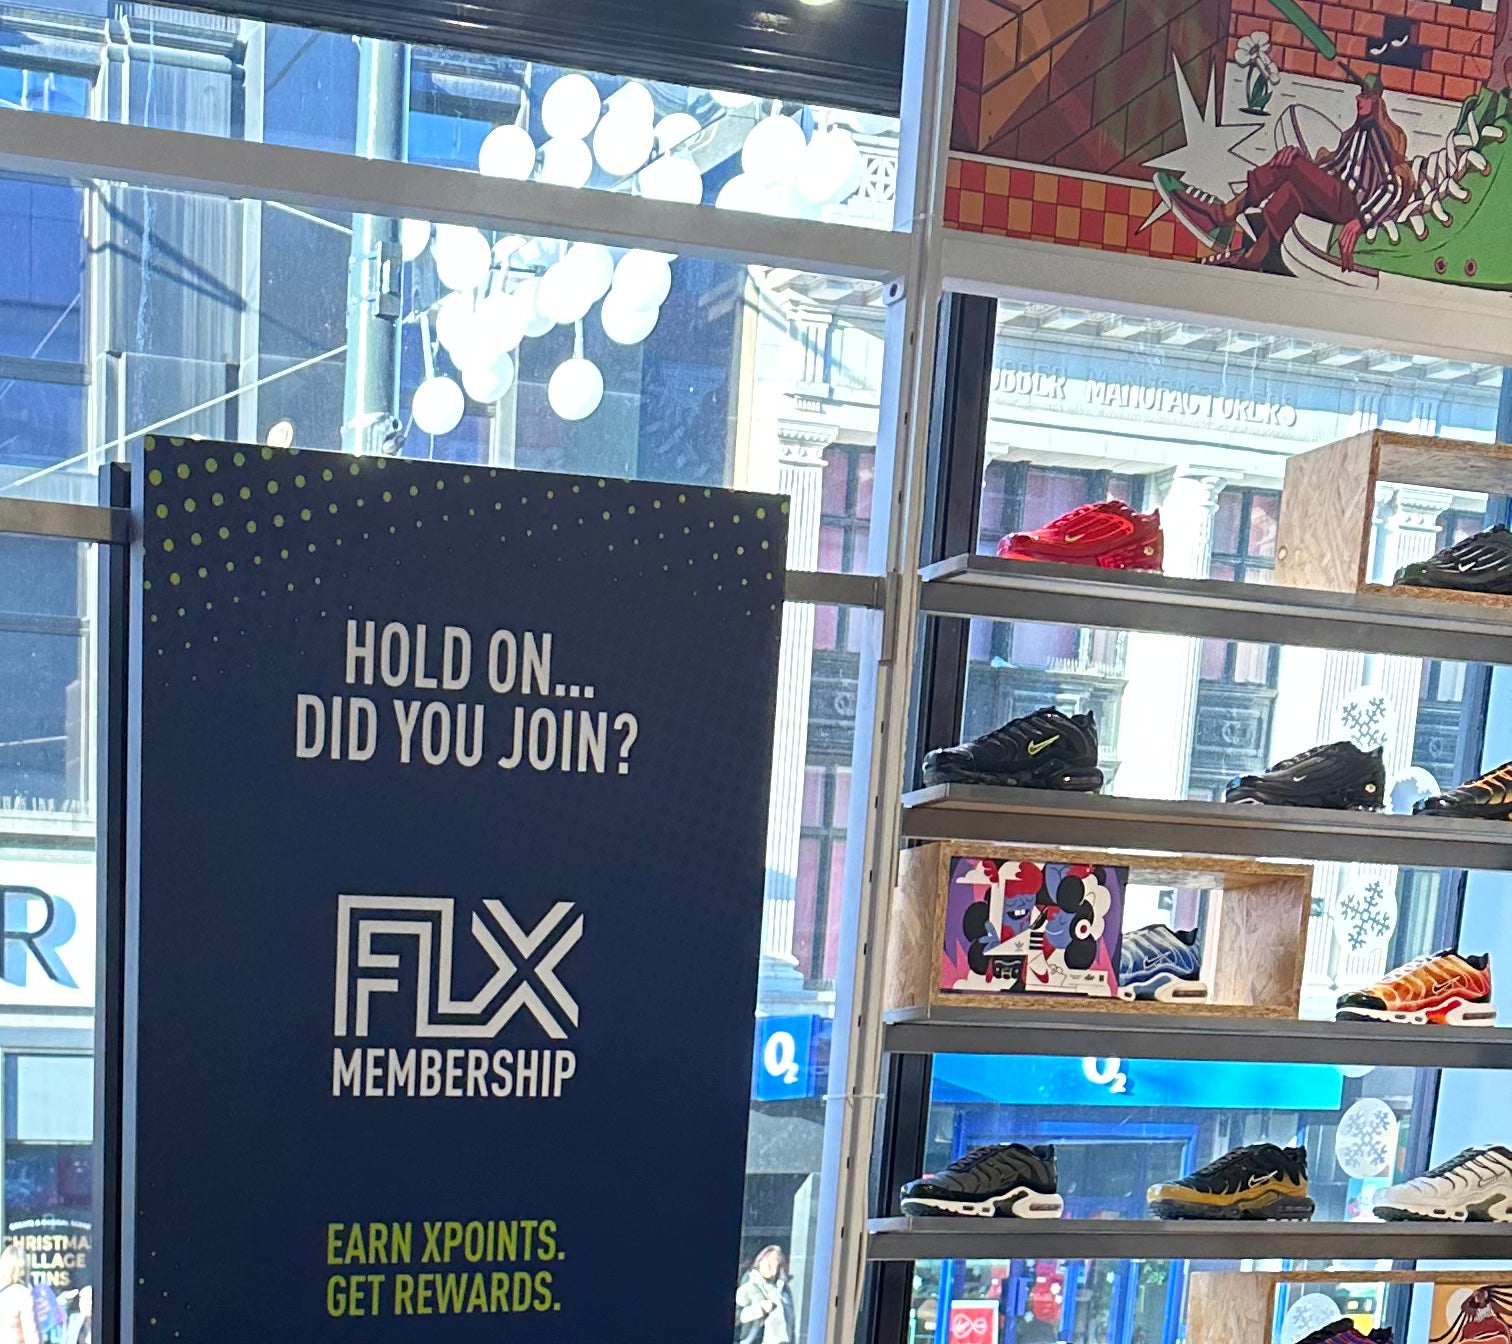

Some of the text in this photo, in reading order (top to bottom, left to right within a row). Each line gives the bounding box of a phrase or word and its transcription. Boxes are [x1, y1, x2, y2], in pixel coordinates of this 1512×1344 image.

[345, 619, 595, 698] HOLD ON...
[296, 694, 639, 775] DID YOU JOIN?
[334, 894, 584, 1039] FLX
[333, 1047, 577, 1098] MEMBERSHIP
[327, 1219, 566, 1265] EARN XPOINTS.
[326, 1271, 561, 1318] GET REWARDS.
